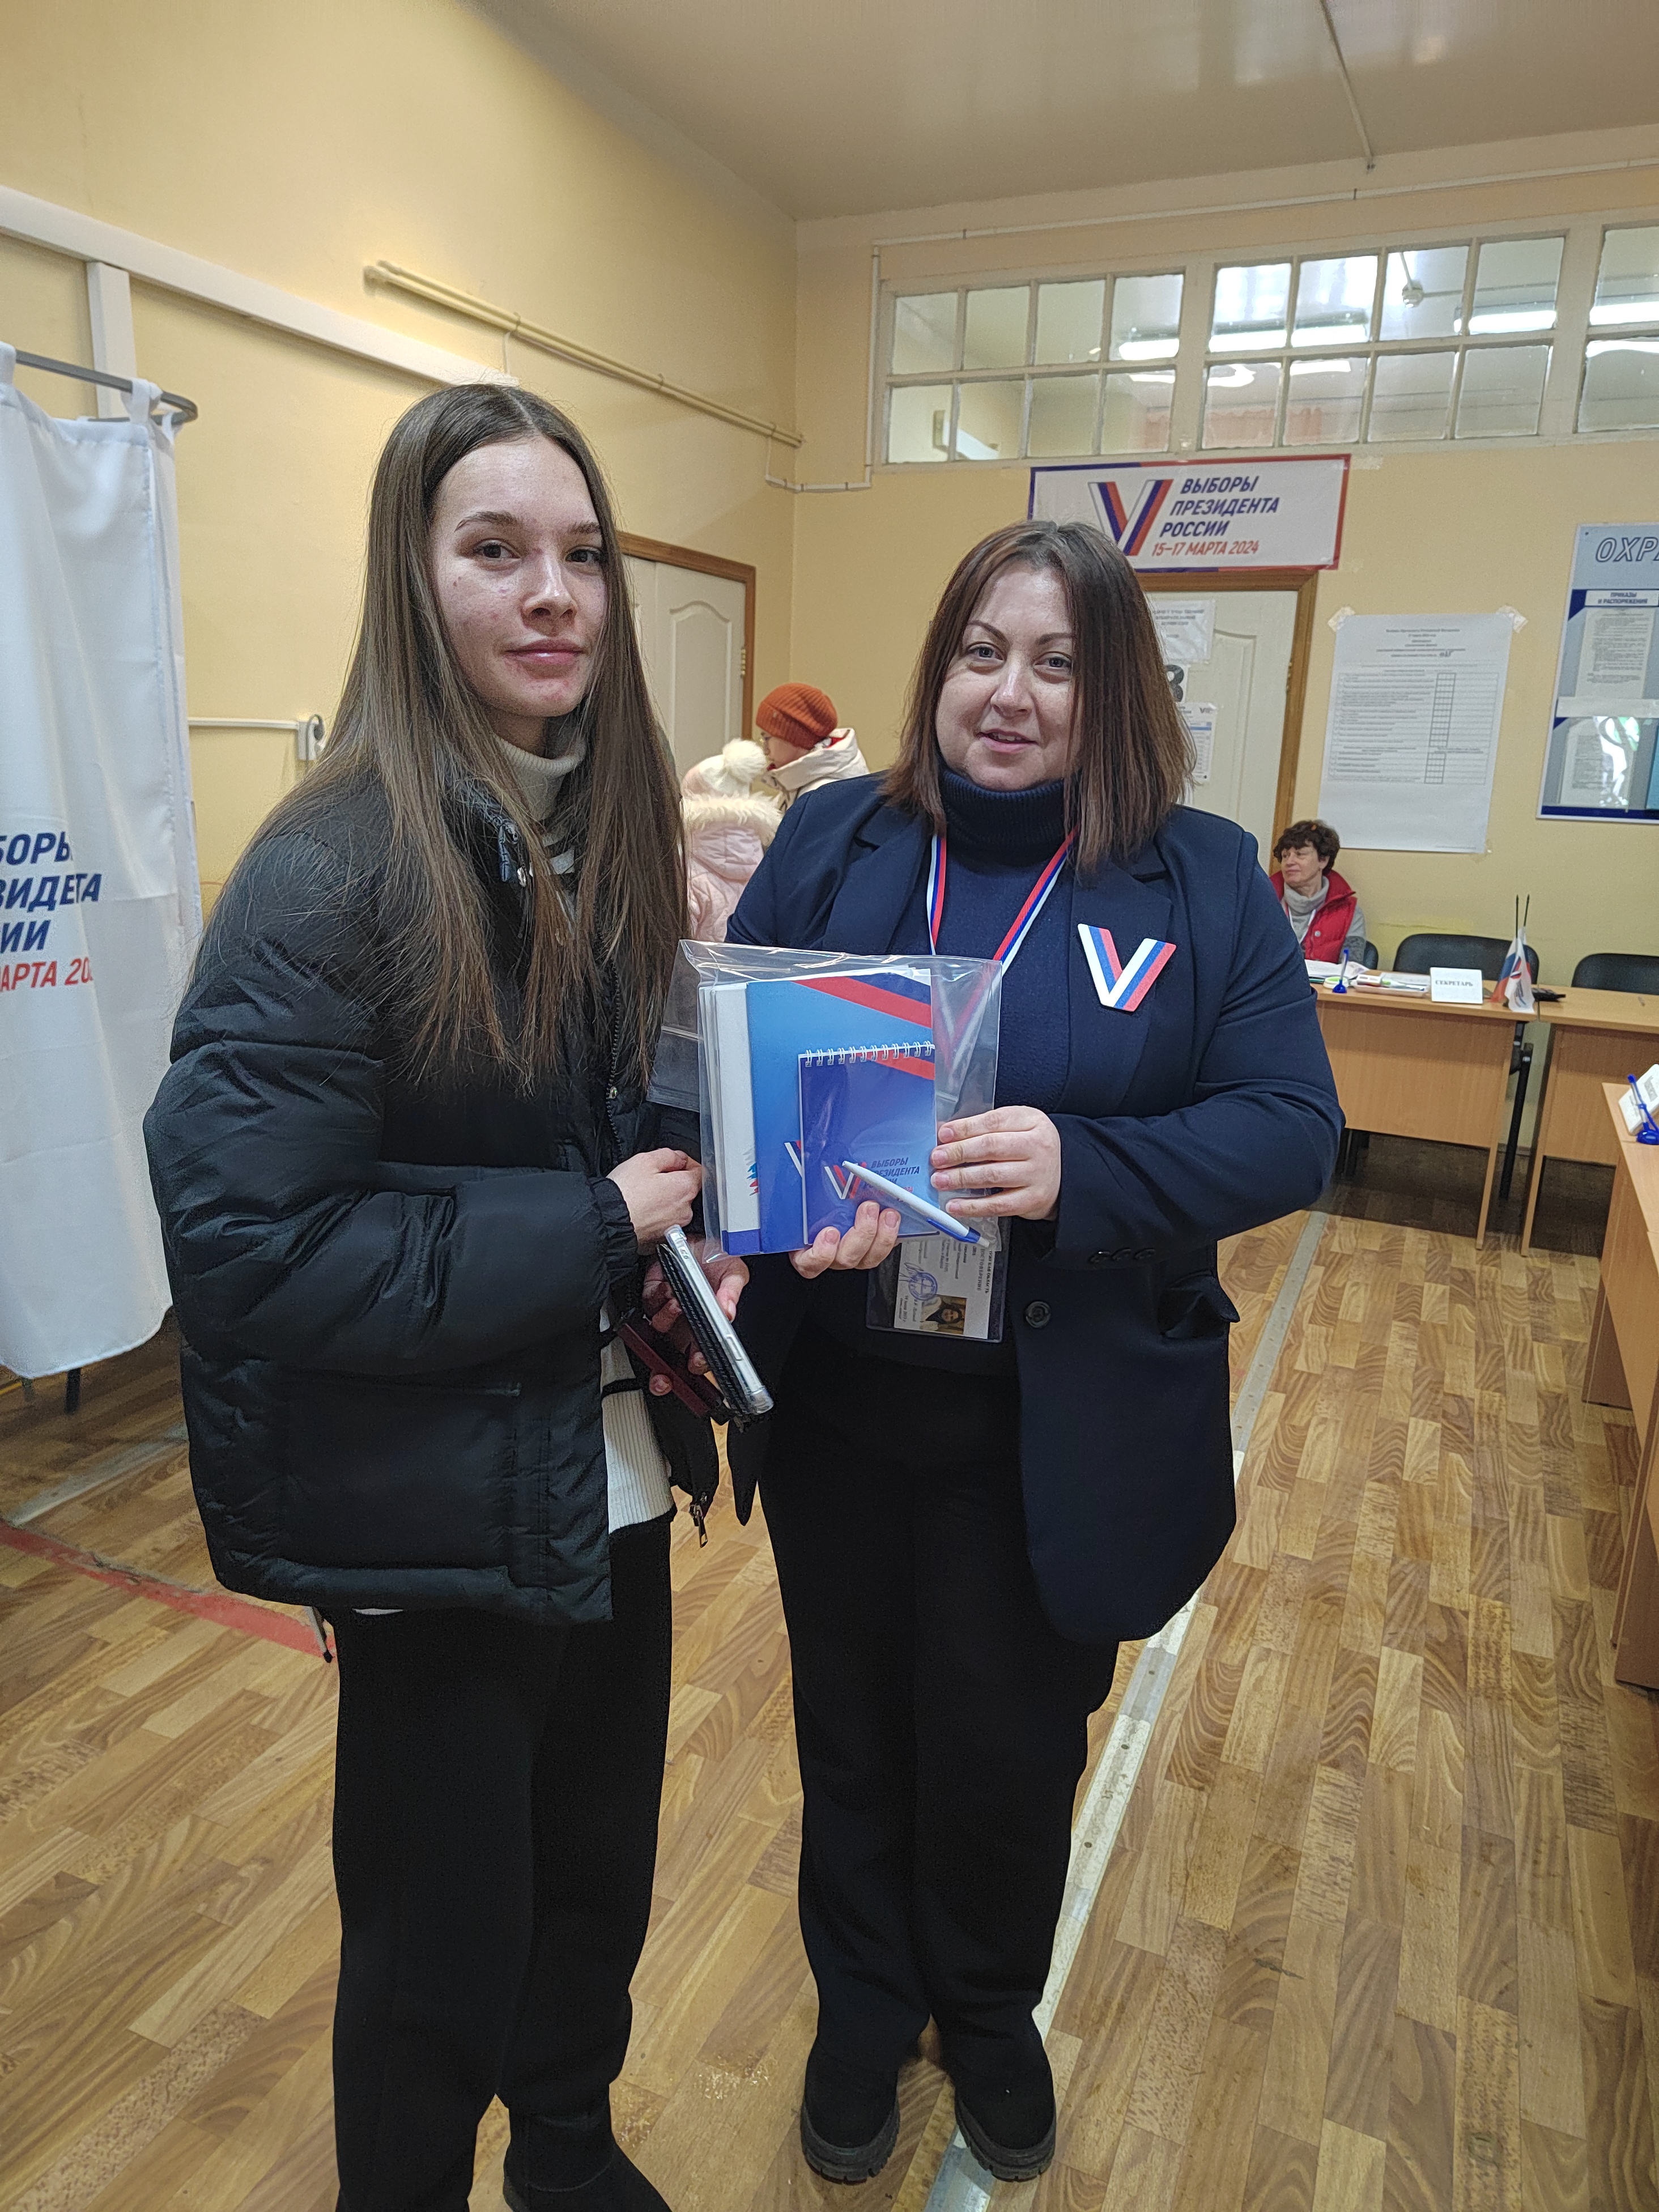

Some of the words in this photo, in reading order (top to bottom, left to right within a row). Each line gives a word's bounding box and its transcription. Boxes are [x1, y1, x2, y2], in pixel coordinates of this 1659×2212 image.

[1180, 475, 1260, 494] ВЫБОРЫ
[1169, 497, 1280, 517] ПРЕЗИДЕНТА
[1159, 520, 1231, 538] РОССИИ
[1185, 541, 1228, 556] МАРТА
[1228, 540, 1260, 555] 2024
[1596, 537, 1659, 562] ОХР
[871, 1157, 908, 1169] ВЫБОРЫ
[872, 1166, 920, 1178] РЕЗИДЕНТА
